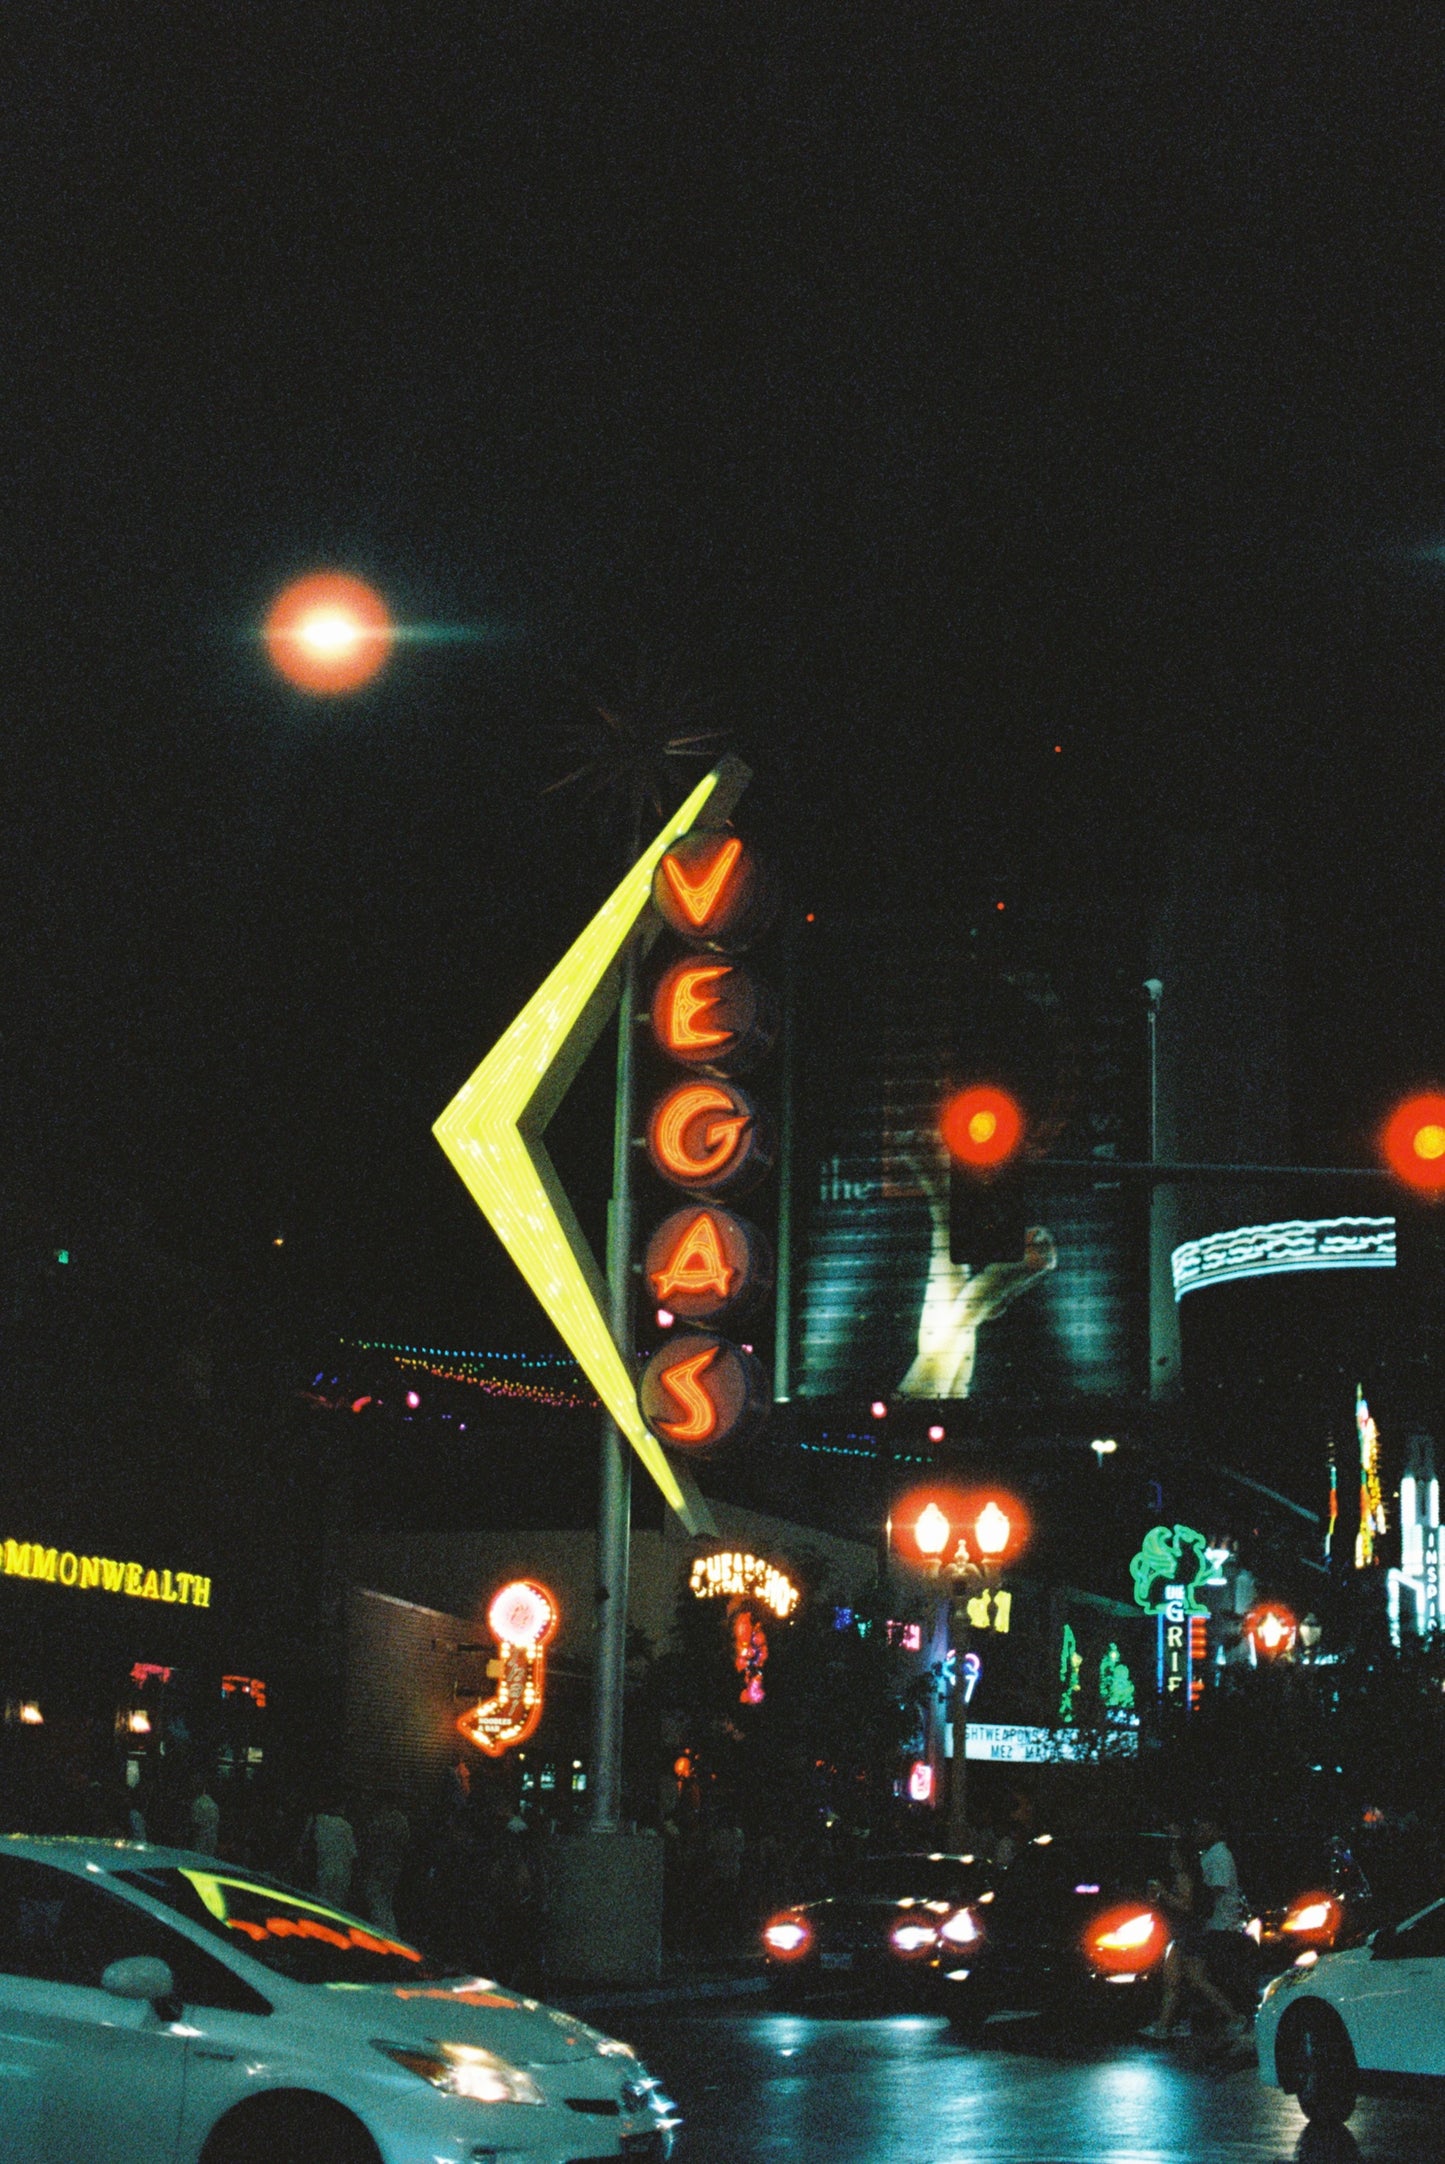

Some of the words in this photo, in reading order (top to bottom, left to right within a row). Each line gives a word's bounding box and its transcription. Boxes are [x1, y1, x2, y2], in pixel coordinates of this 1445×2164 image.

[652, 838, 752, 1440] VEGAS
[0, 1538, 211, 1607] MMONWEALTH
[1165, 1601, 1184, 1697] GRIF
